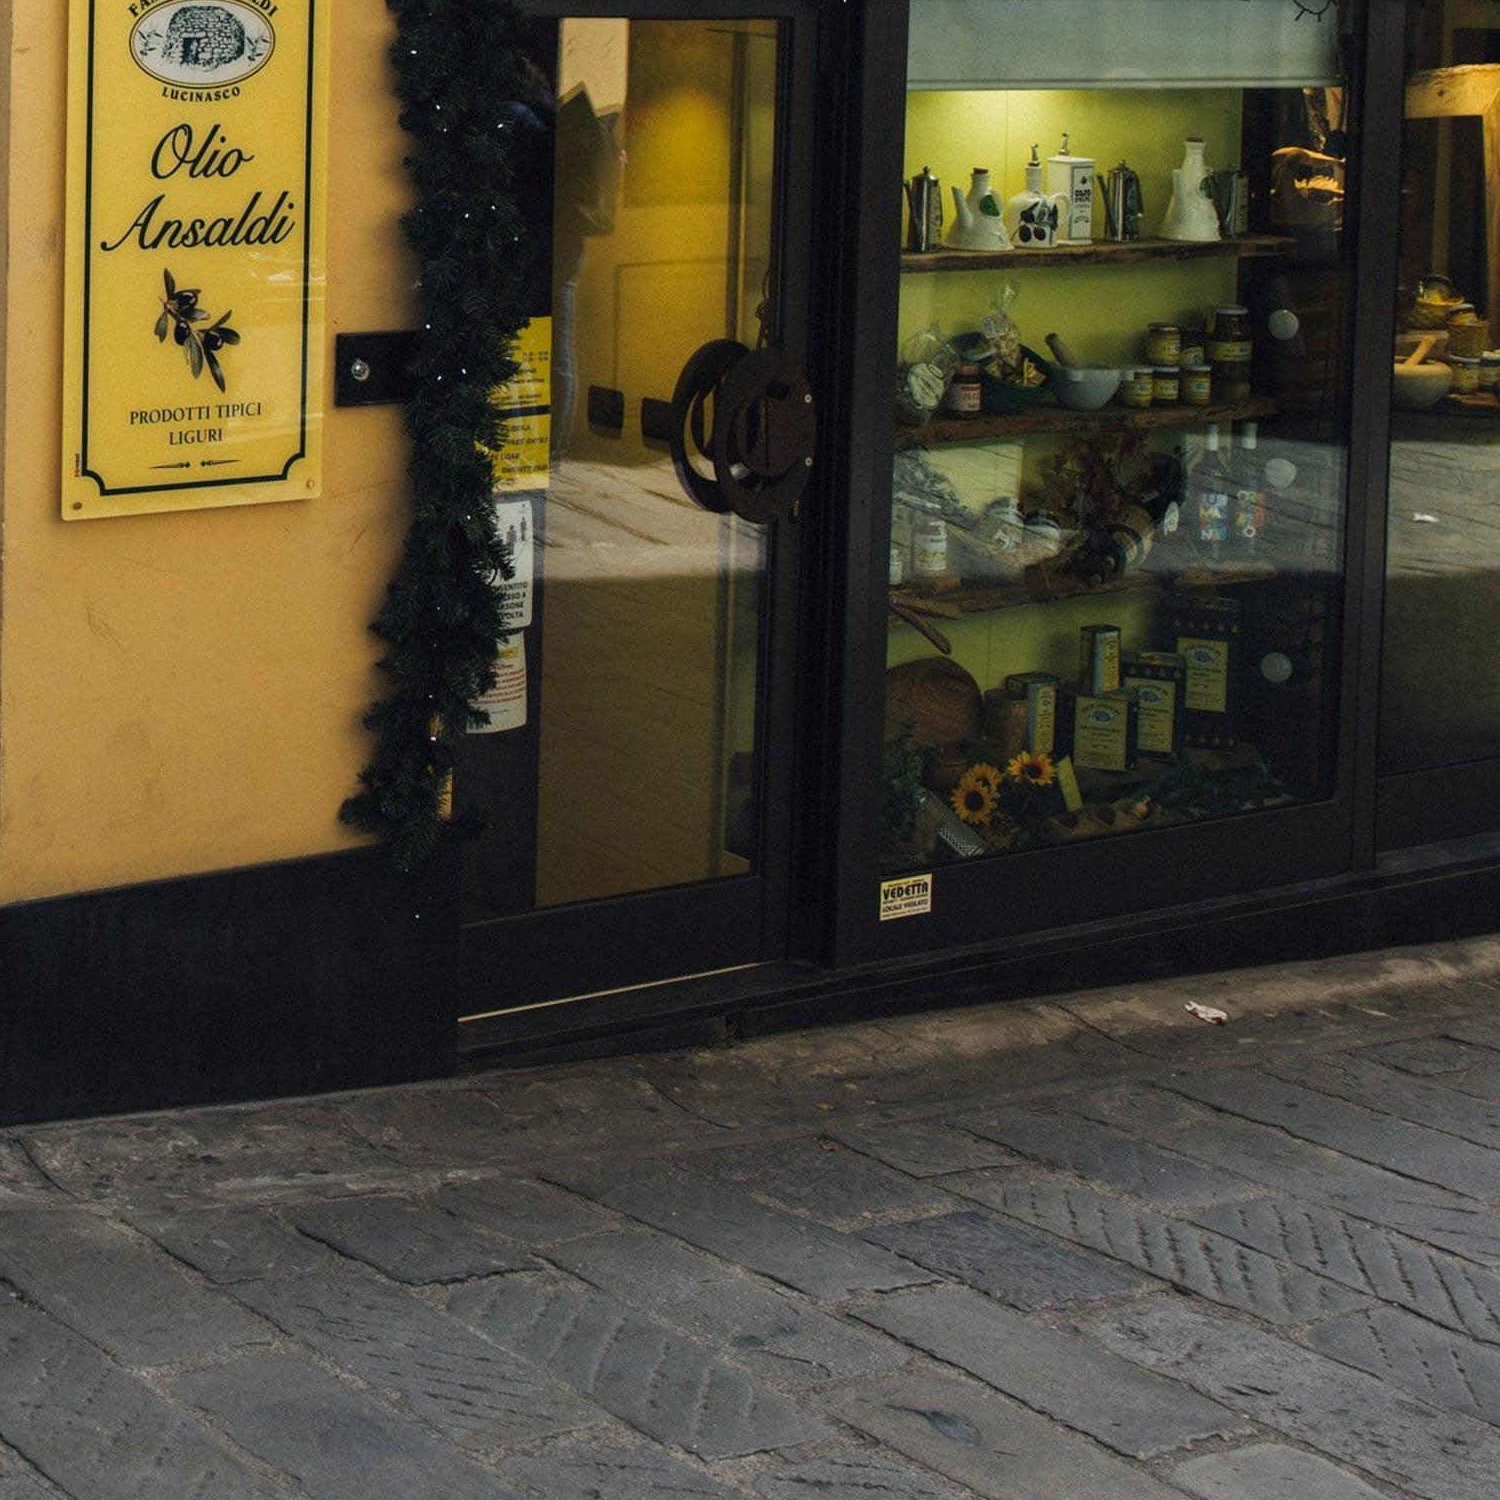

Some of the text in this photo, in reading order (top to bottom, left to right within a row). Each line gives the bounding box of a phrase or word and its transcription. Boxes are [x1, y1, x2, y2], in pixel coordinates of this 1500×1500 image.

[162, 86, 241, 102] LUCINASCO
[151, 123, 254, 179] Olio
[100, 191, 295, 251] Ansaldi
[129, 402, 262, 425] PRODOTTI TIPICI
[169, 428, 223, 445] LIGURI
[883, 882, 928, 900] VEDETTA
